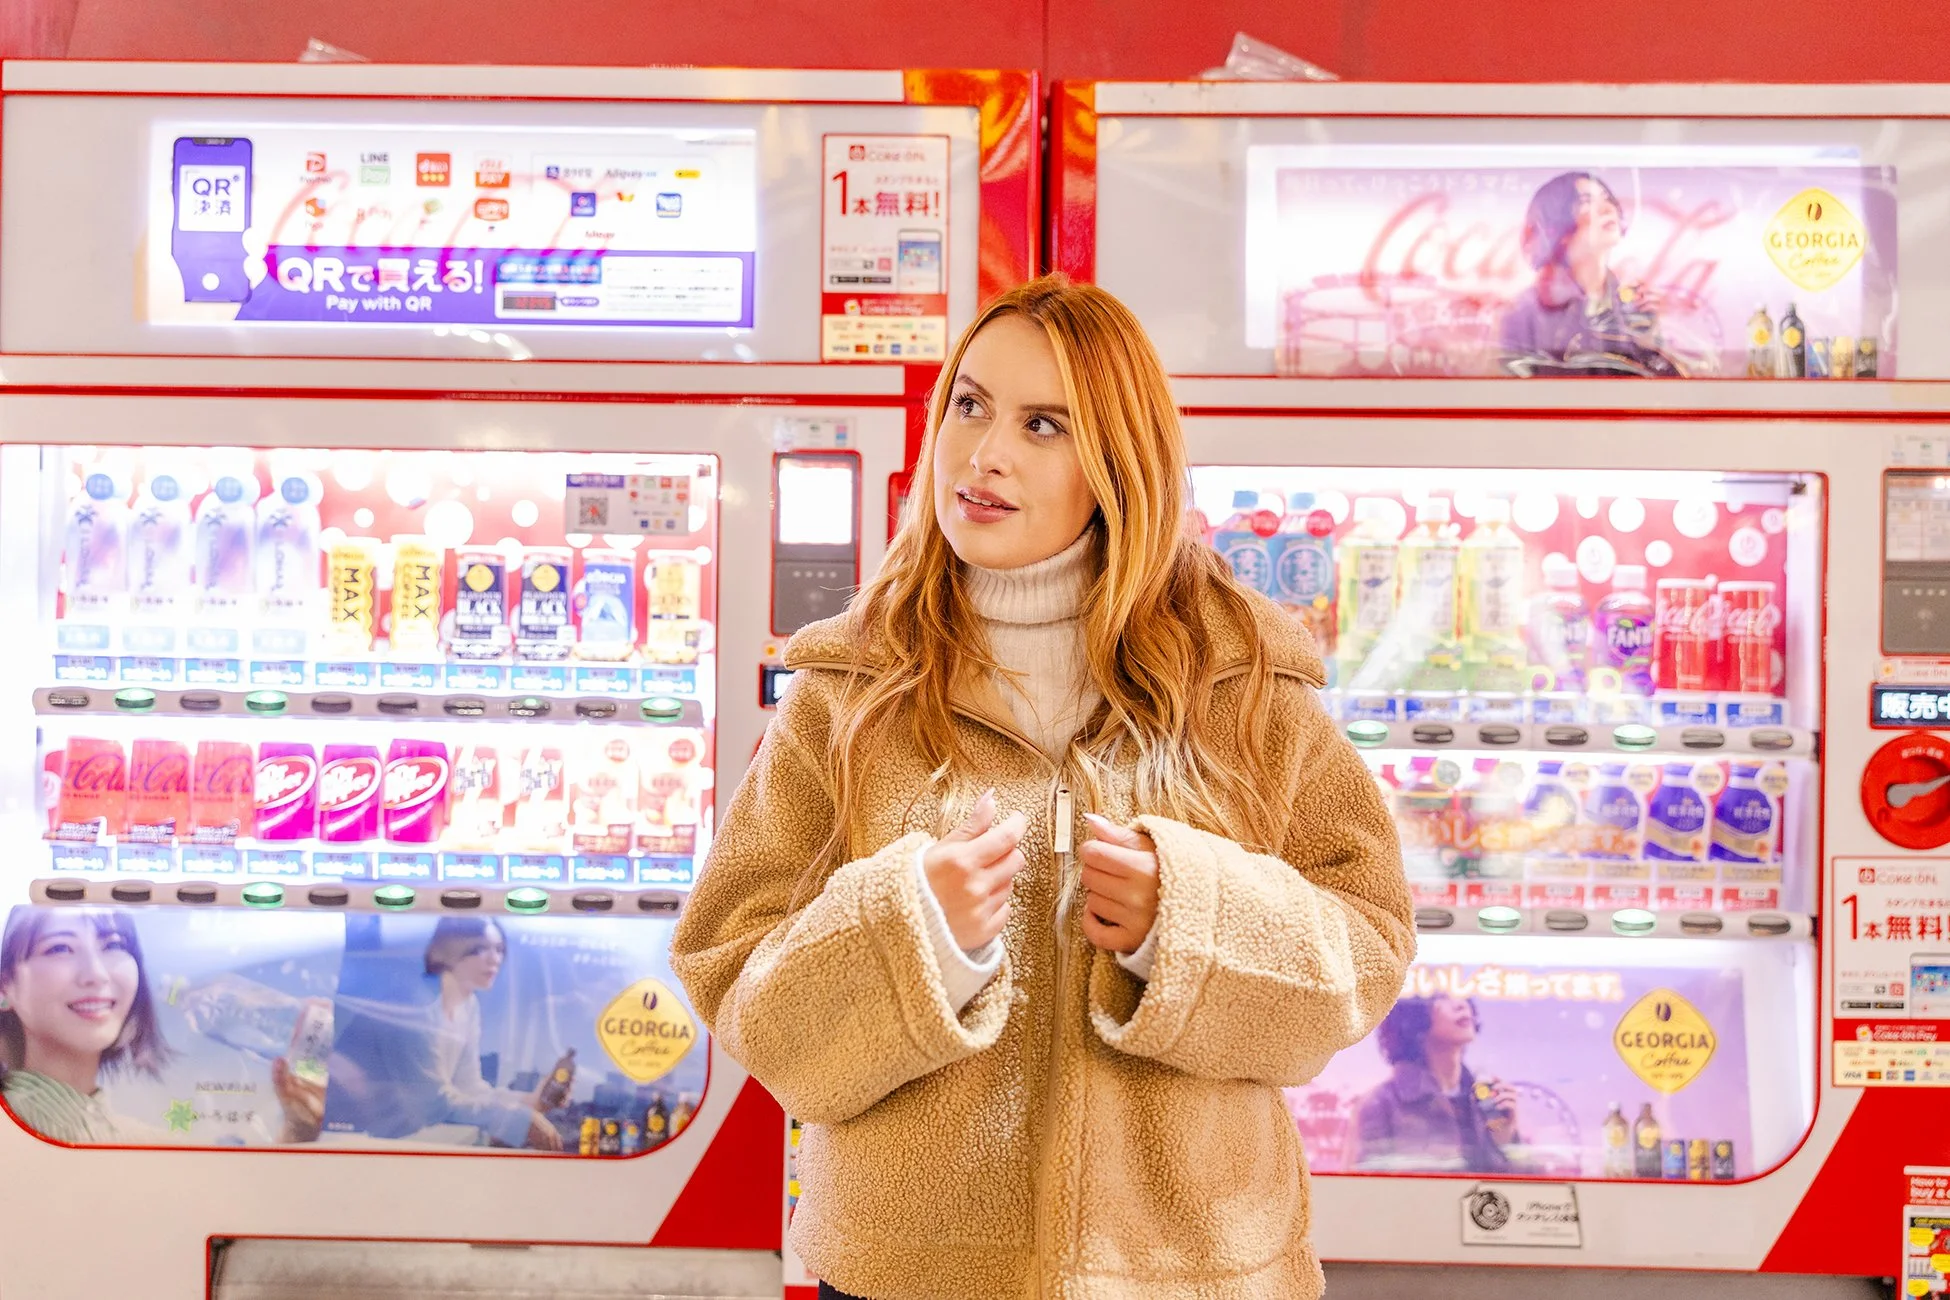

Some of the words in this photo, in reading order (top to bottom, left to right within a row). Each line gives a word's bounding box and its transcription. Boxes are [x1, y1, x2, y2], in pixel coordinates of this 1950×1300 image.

[193, 199, 232, 216] 決済
[1769, 231, 1860, 248] GEORGIA
[326, 295, 359, 314] Pay
[364, 296, 401, 311] with
[405, 296, 433, 313] QR
[343, 567, 360, 621] MAX
[414, 564, 431, 618] MAX
[603, 1018, 691, 1040] GEORGIA
[620, 1039, 671, 1057] Coffee
[1620, 1031, 1710, 1050] GEORGIA
[1641, 1051, 1692, 1070] Coffee
